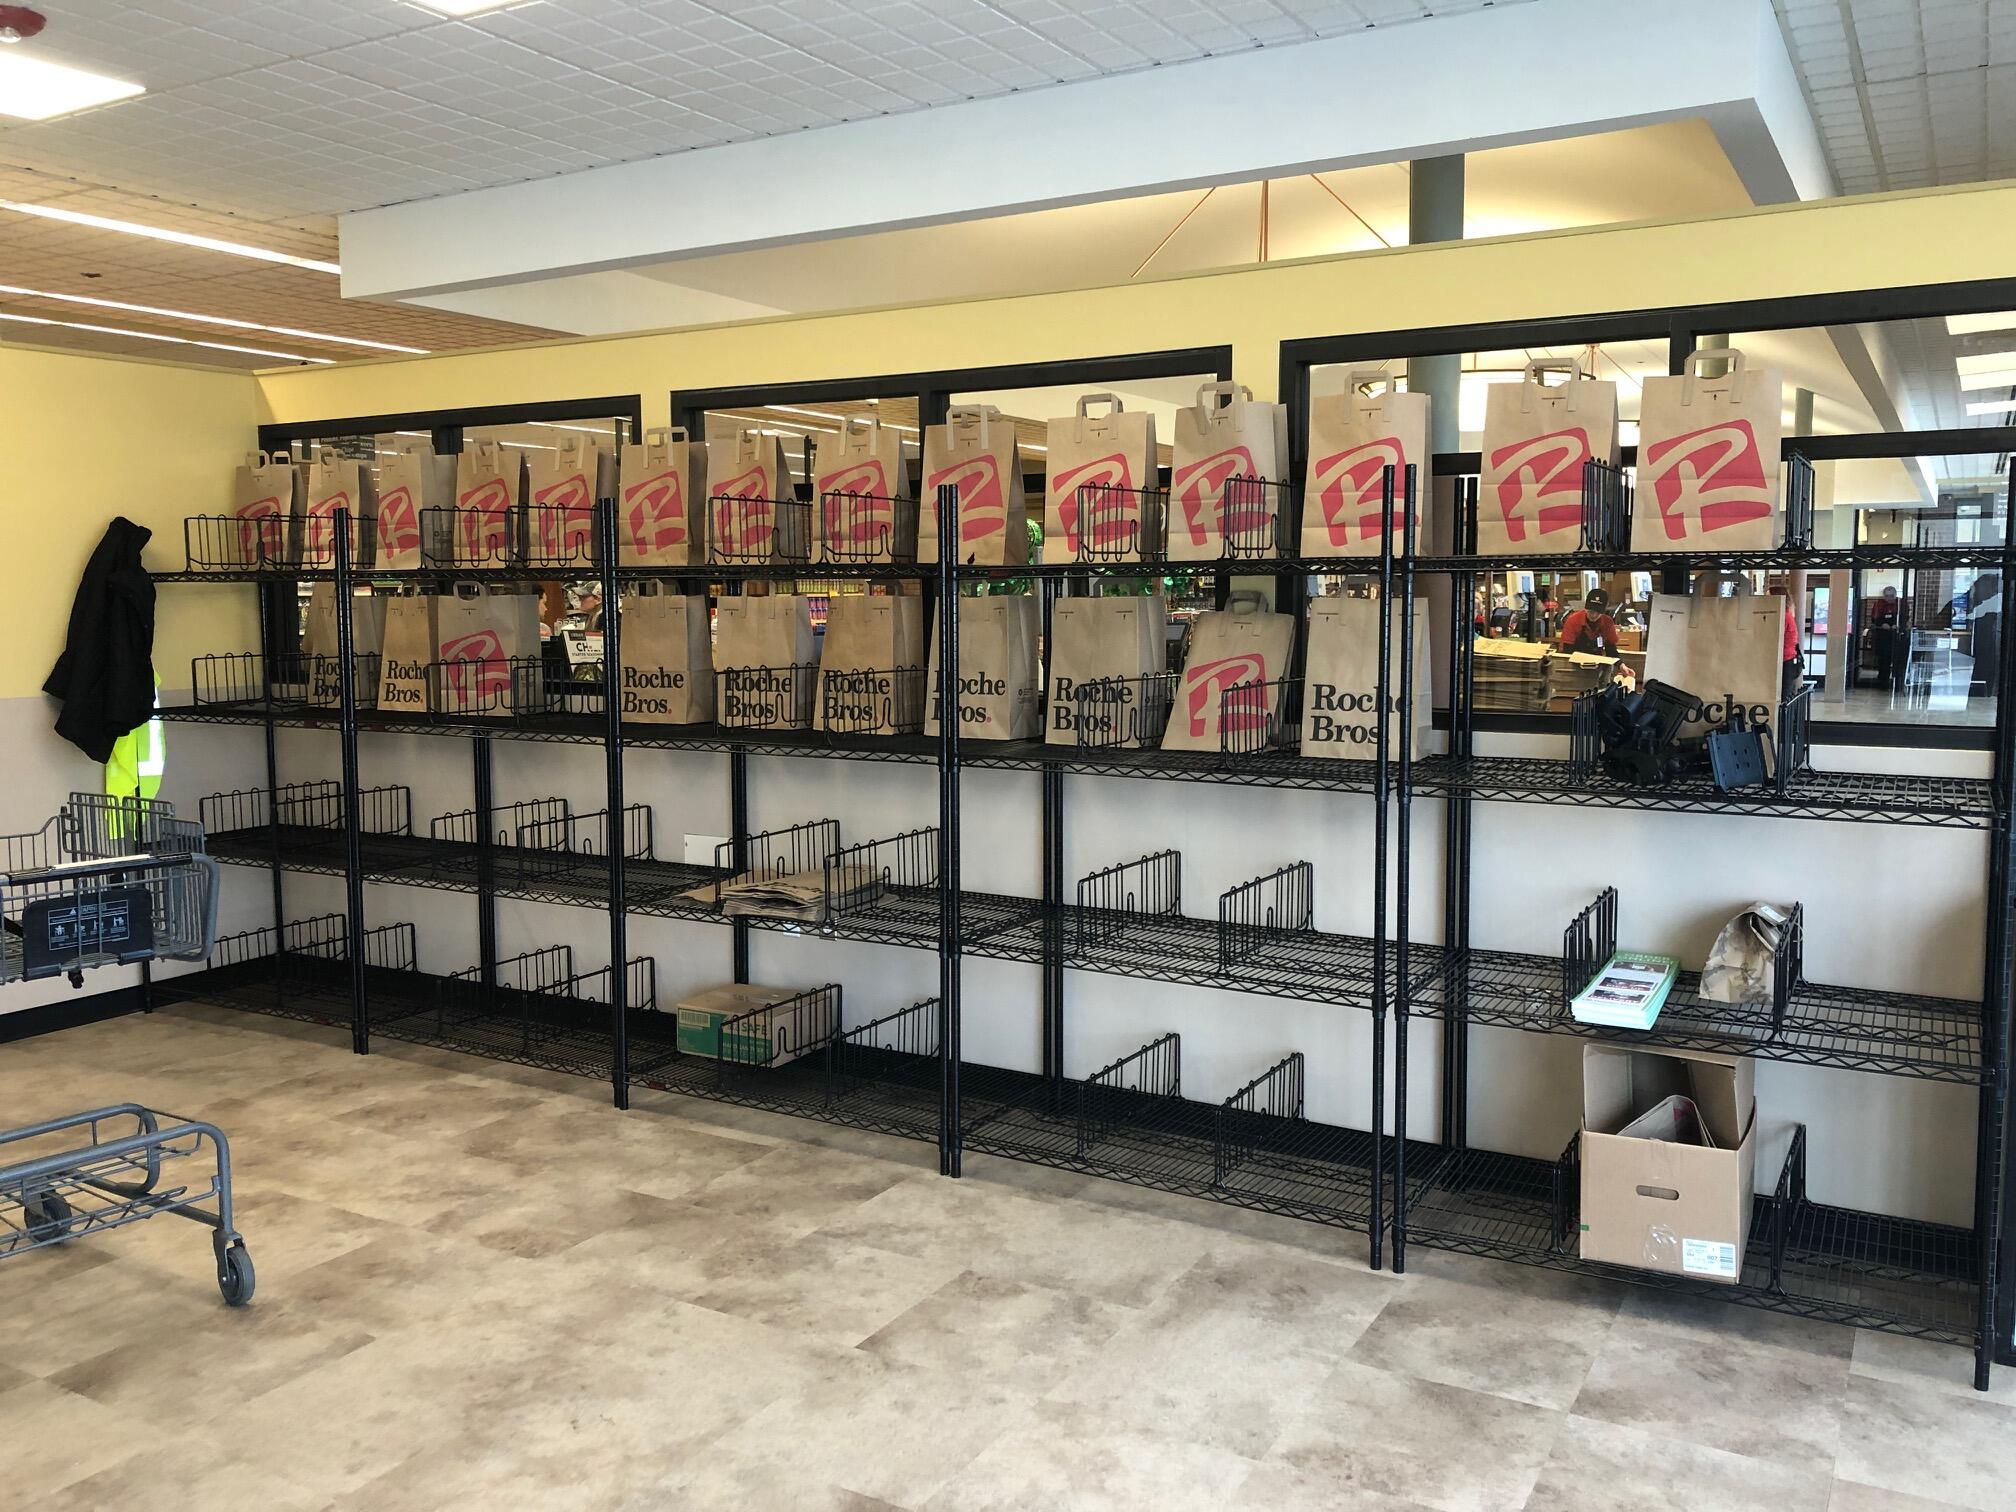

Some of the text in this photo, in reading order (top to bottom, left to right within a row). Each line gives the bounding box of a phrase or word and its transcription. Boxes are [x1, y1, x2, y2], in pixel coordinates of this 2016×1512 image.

[623, 666, 684, 689] Roche
[724, 667, 792, 693] Roche
[823, 669, 891, 696] Roche
[1053, 677, 1134, 703] Roche
[383, 682, 424, 704] Bros.
[621, 691, 673, 715] Bros.
[930, 697, 993, 723] os.
[1682, 693, 1770, 725] oche
